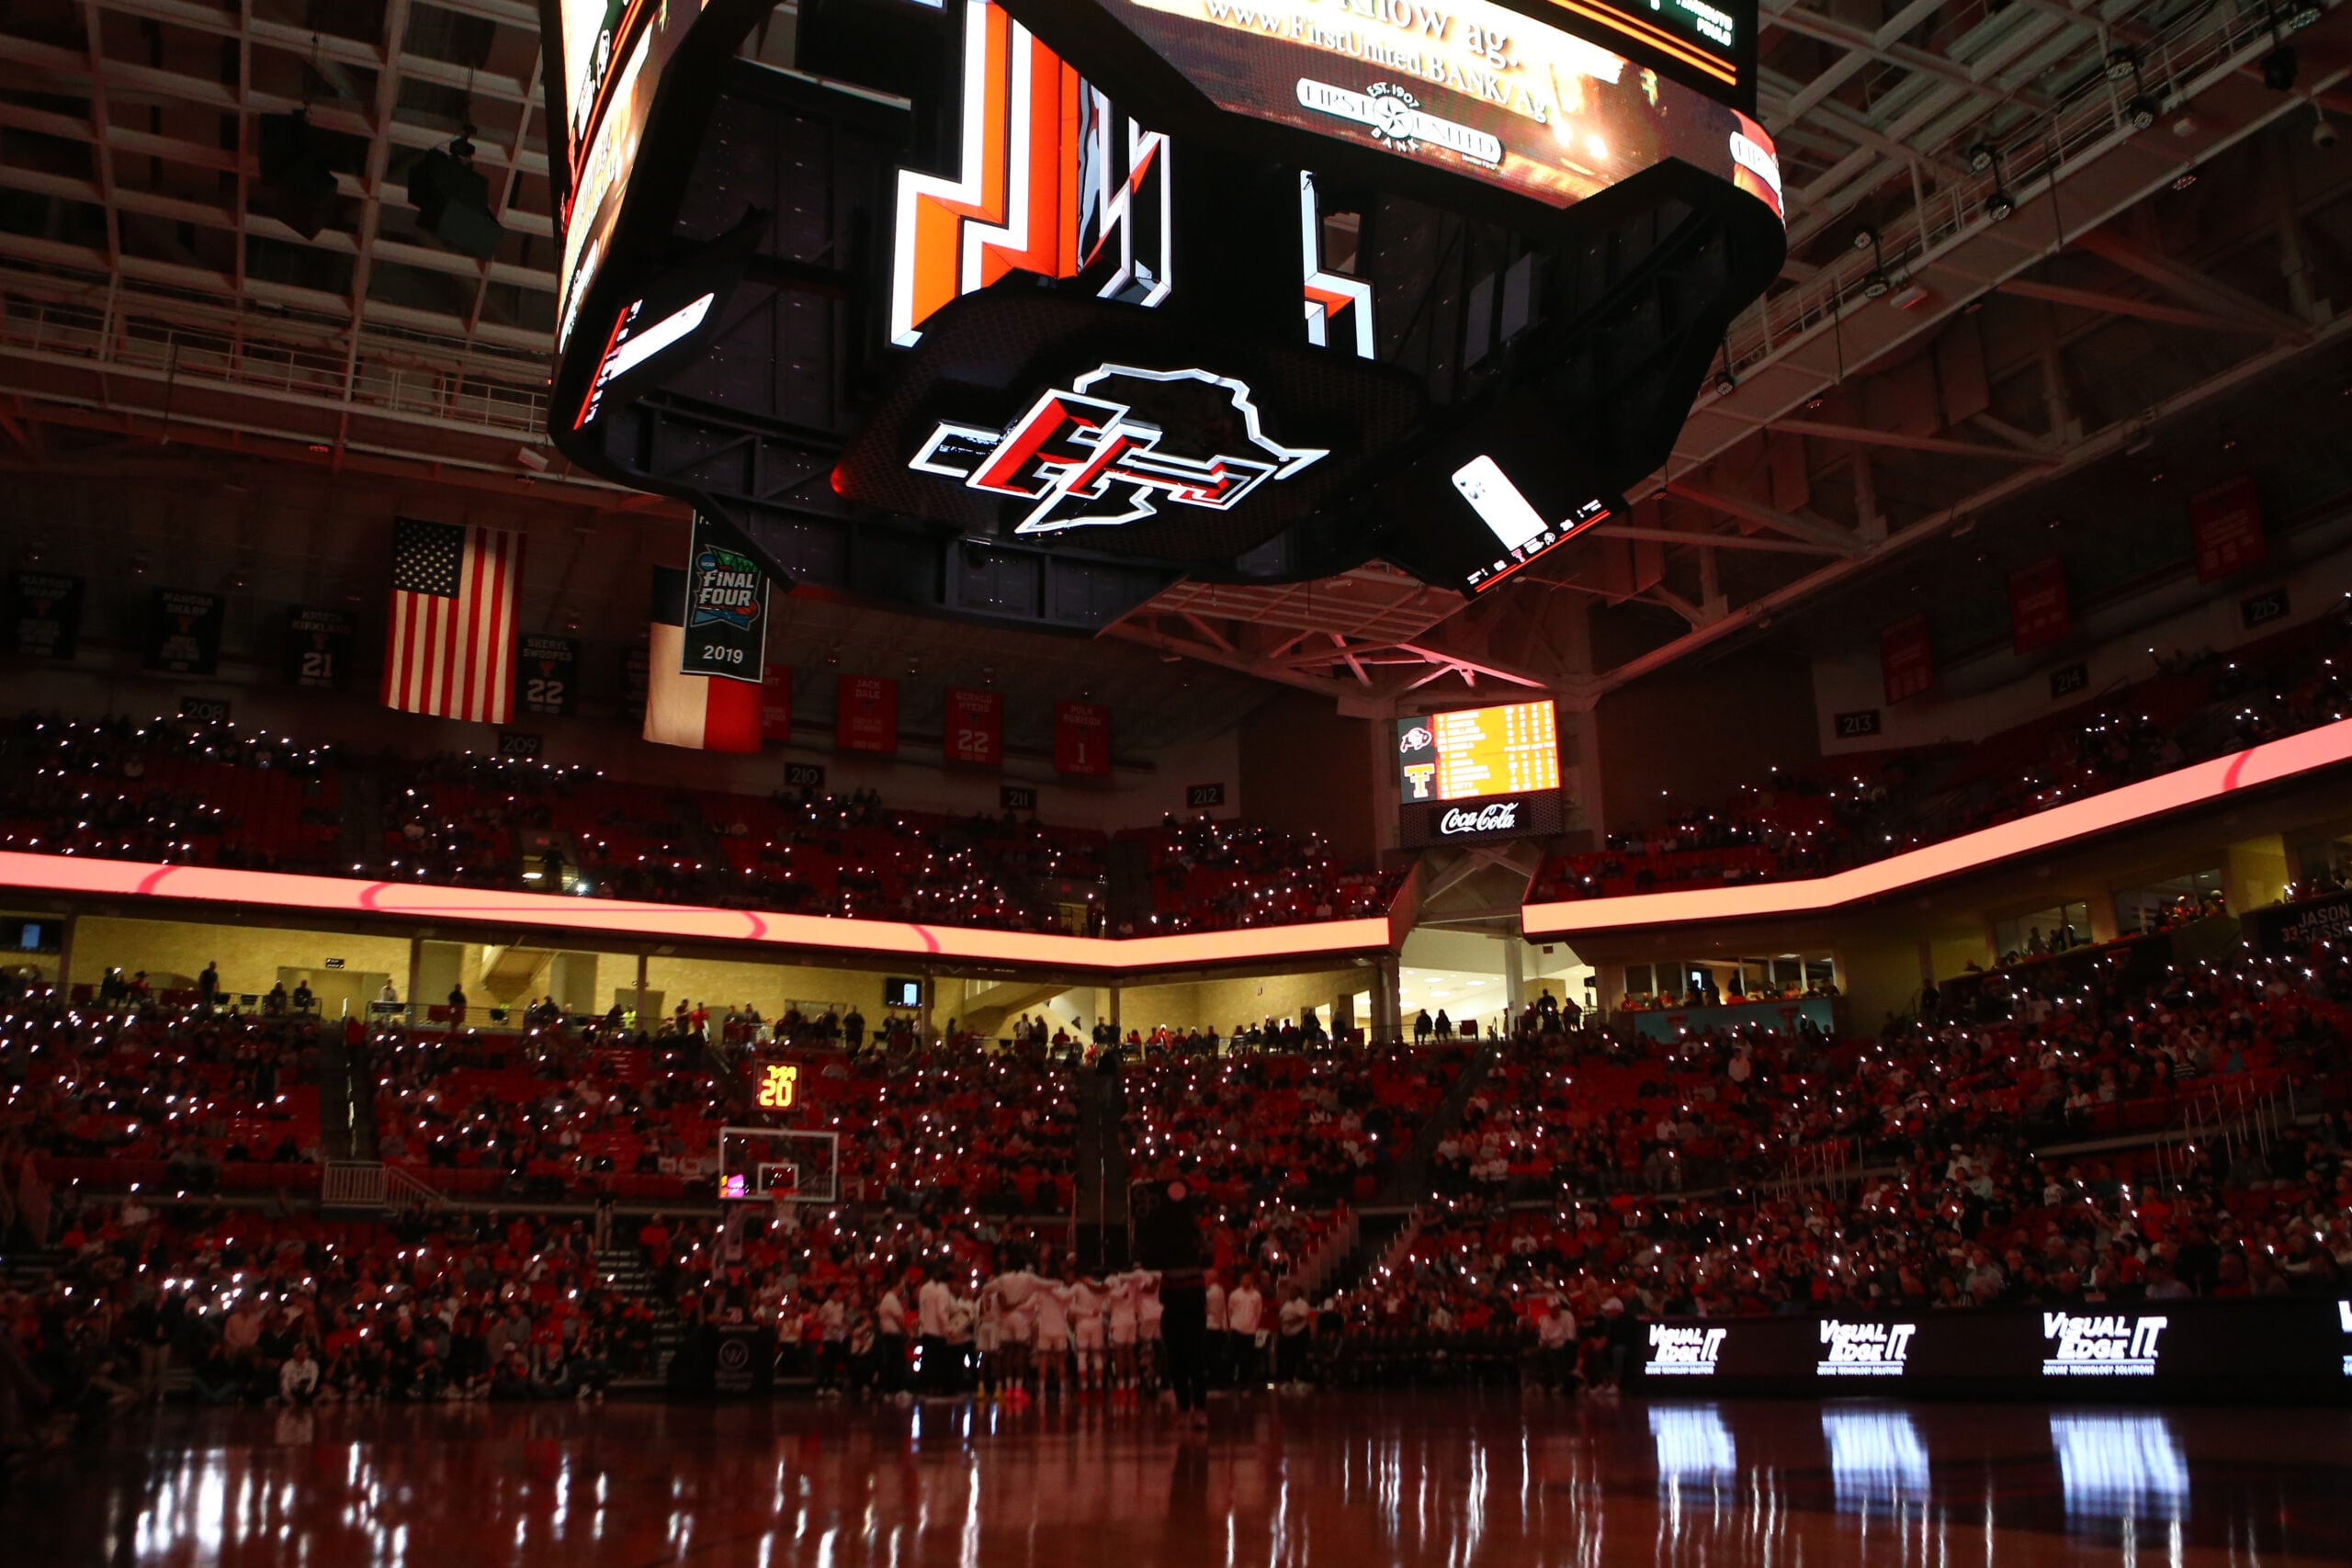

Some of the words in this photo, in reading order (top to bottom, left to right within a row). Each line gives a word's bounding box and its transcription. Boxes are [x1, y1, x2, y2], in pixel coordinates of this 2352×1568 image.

[1391, 84, 1420, 109] 1907
[1370, 126, 1419, 152] BANK
[703, 570, 754, 588] FINAL
[699, 588, 752, 607] FOUR
[2250, 594, 2279, 622] 215
[301, 651, 333, 678] 21
[522, 649, 573, 661] SWOOPES
[702, 645, 743, 664] 2019
[854, 678, 882, 690] JACK
[2057, 669, 2081, 692] 214
[526, 678, 565, 705] 22
[854, 688, 882, 699] DALE
[185, 701, 224, 720] 208
[1844, 715, 1872, 734] 213
[503, 736, 537, 754] 209
[957, 729, 989, 753] 22
[1077, 742, 1086, 764] 1
[791, 767, 818, 784] 210
[1009, 791, 1028, 807] 211
[1193, 787, 1218, 805] 212
[2298, 903, 2351, 928] JASON
[759, 1078, 793, 1108] 20
[1649, 1324, 1703, 1346] VISUAL
[1819, 1319, 1888, 1344] VISUAL
[2042, 1311, 2132, 1339] VISUAL
[1655, 1343, 1702, 1362] EDGE
[1827, 1342, 1886, 1362] EDGE
[2055, 1337, 2129, 1360] EDGE
